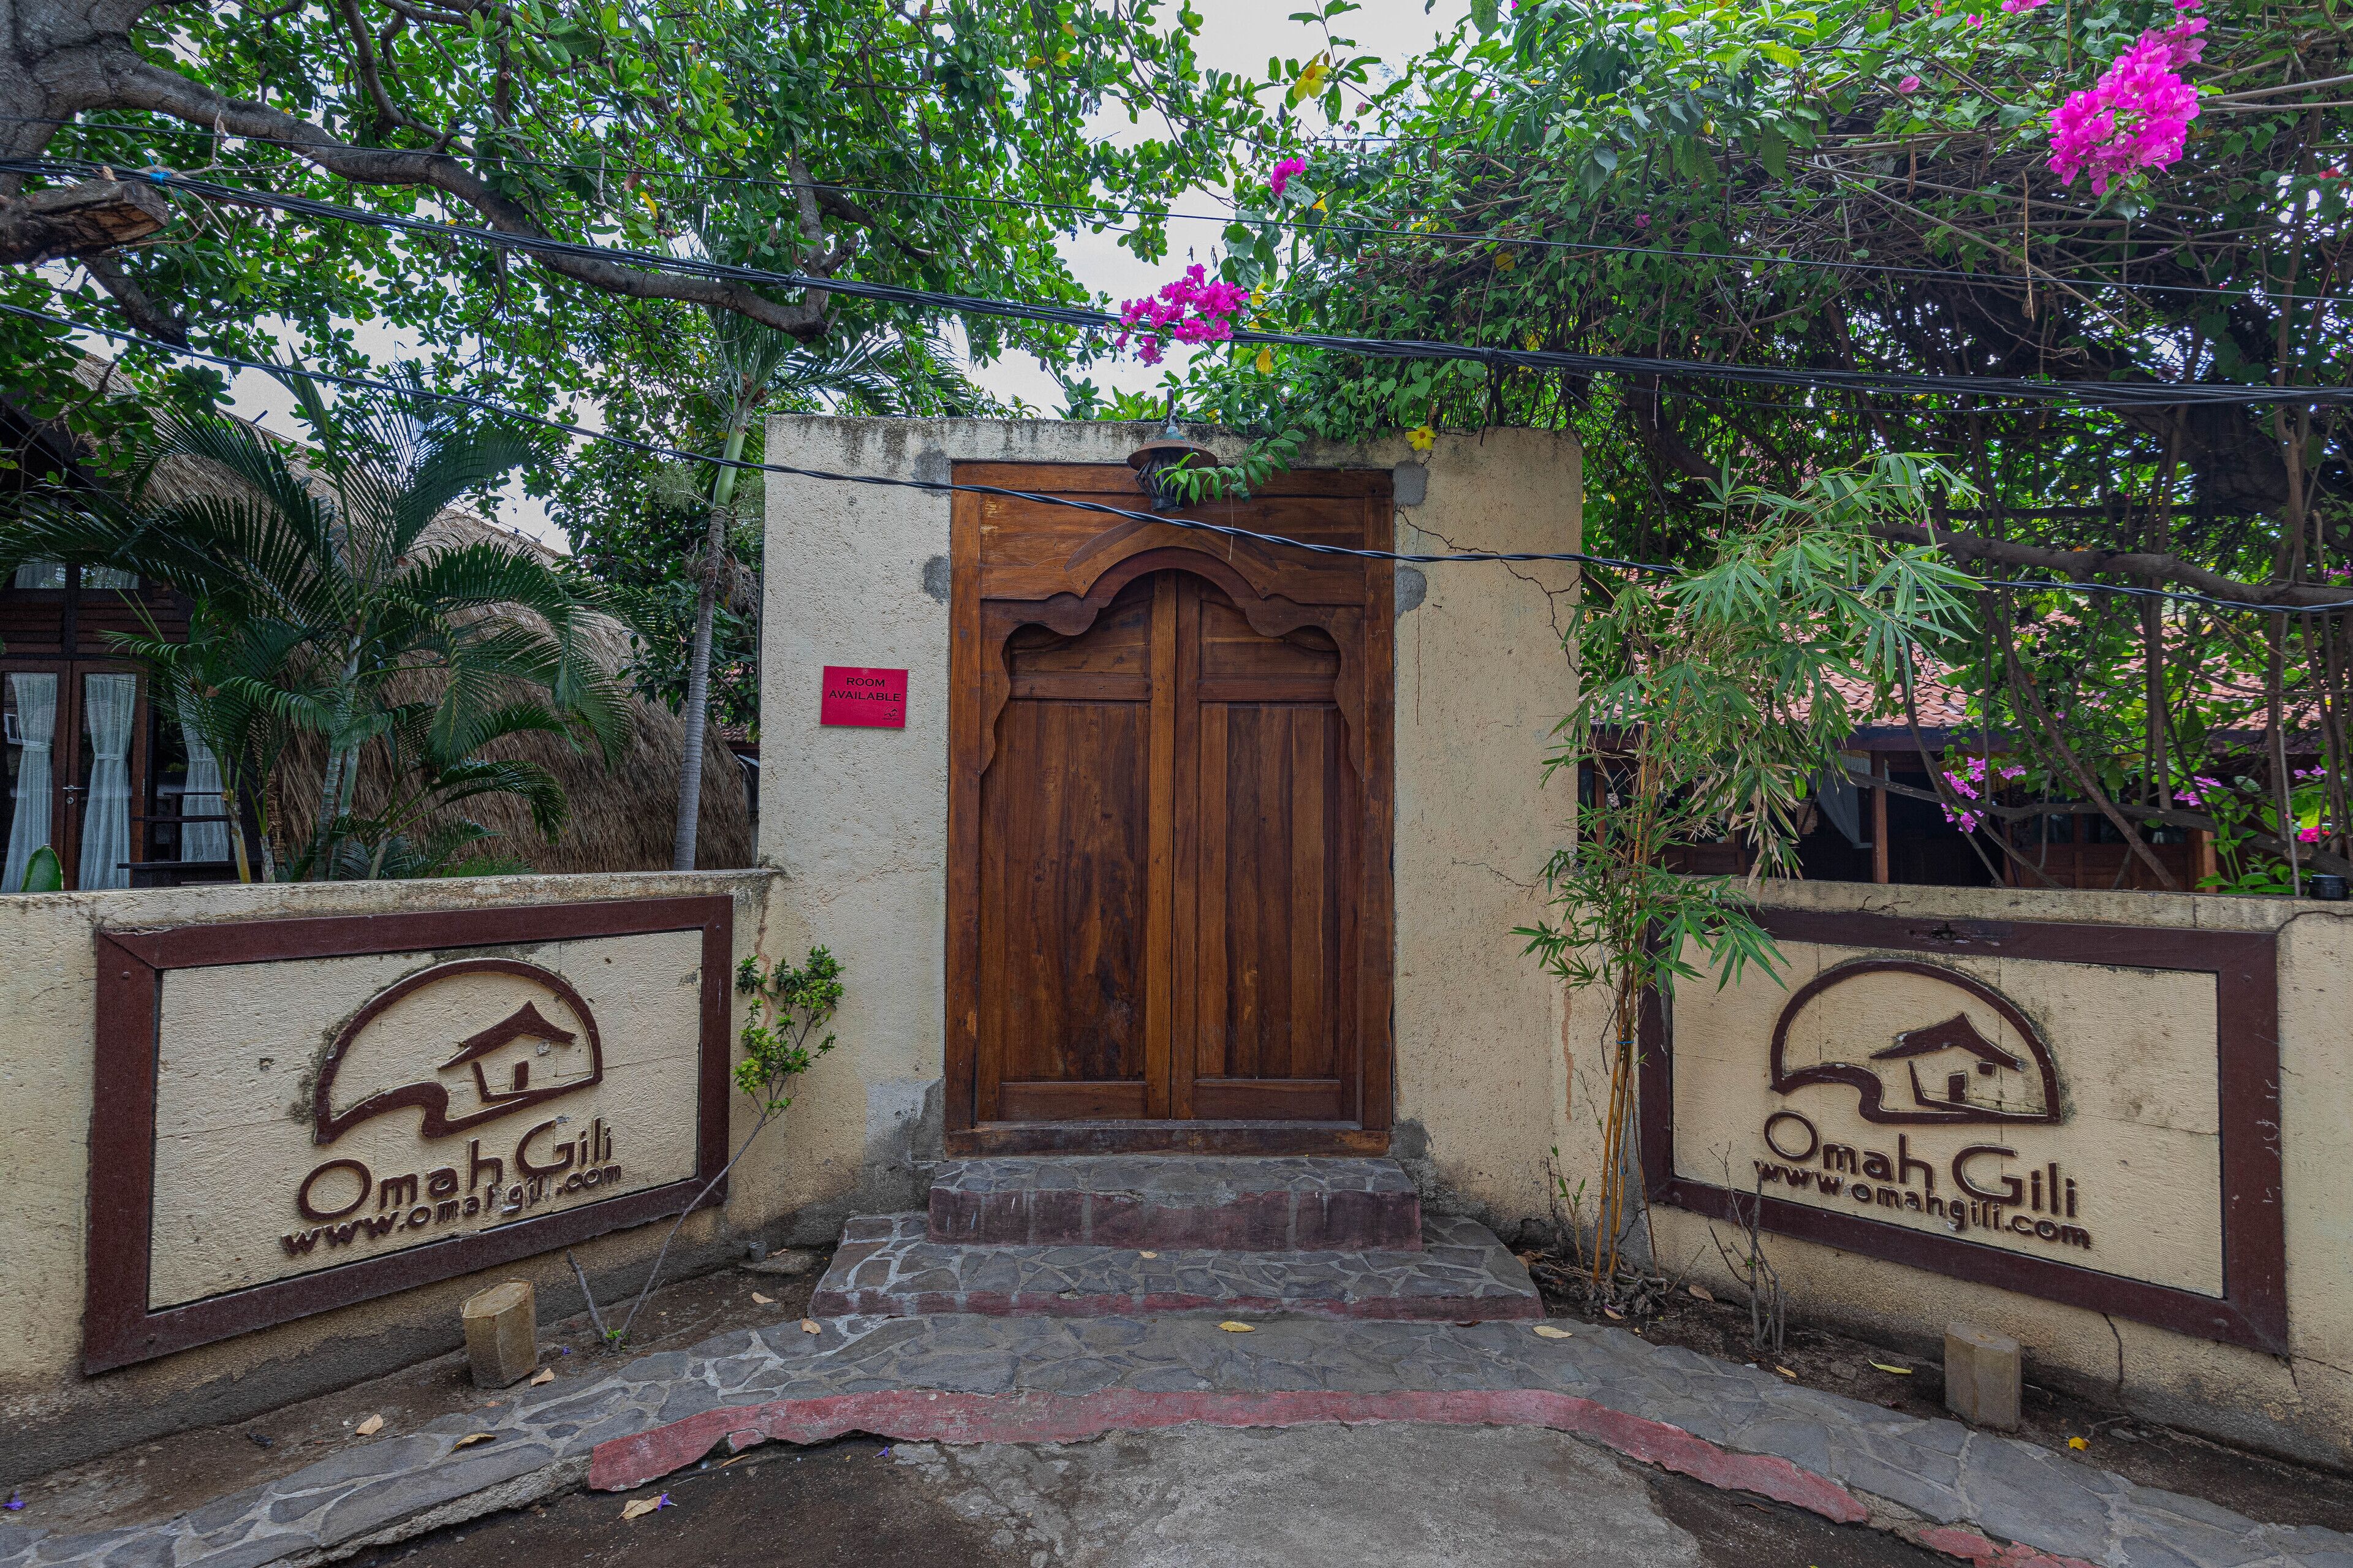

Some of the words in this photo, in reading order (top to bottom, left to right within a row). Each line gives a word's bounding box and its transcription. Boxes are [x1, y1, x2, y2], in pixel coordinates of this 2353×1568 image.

[828, 690, 901, 702] AVAILABLE
[846, 677, 885, 687] ROOM
[297, 1138, 503, 1221] Omah
[515, 1117, 612, 1176] Gili
[1764, 1110, 1933, 1190] Omah
[1952, 1144, 2076, 1217] Gili
